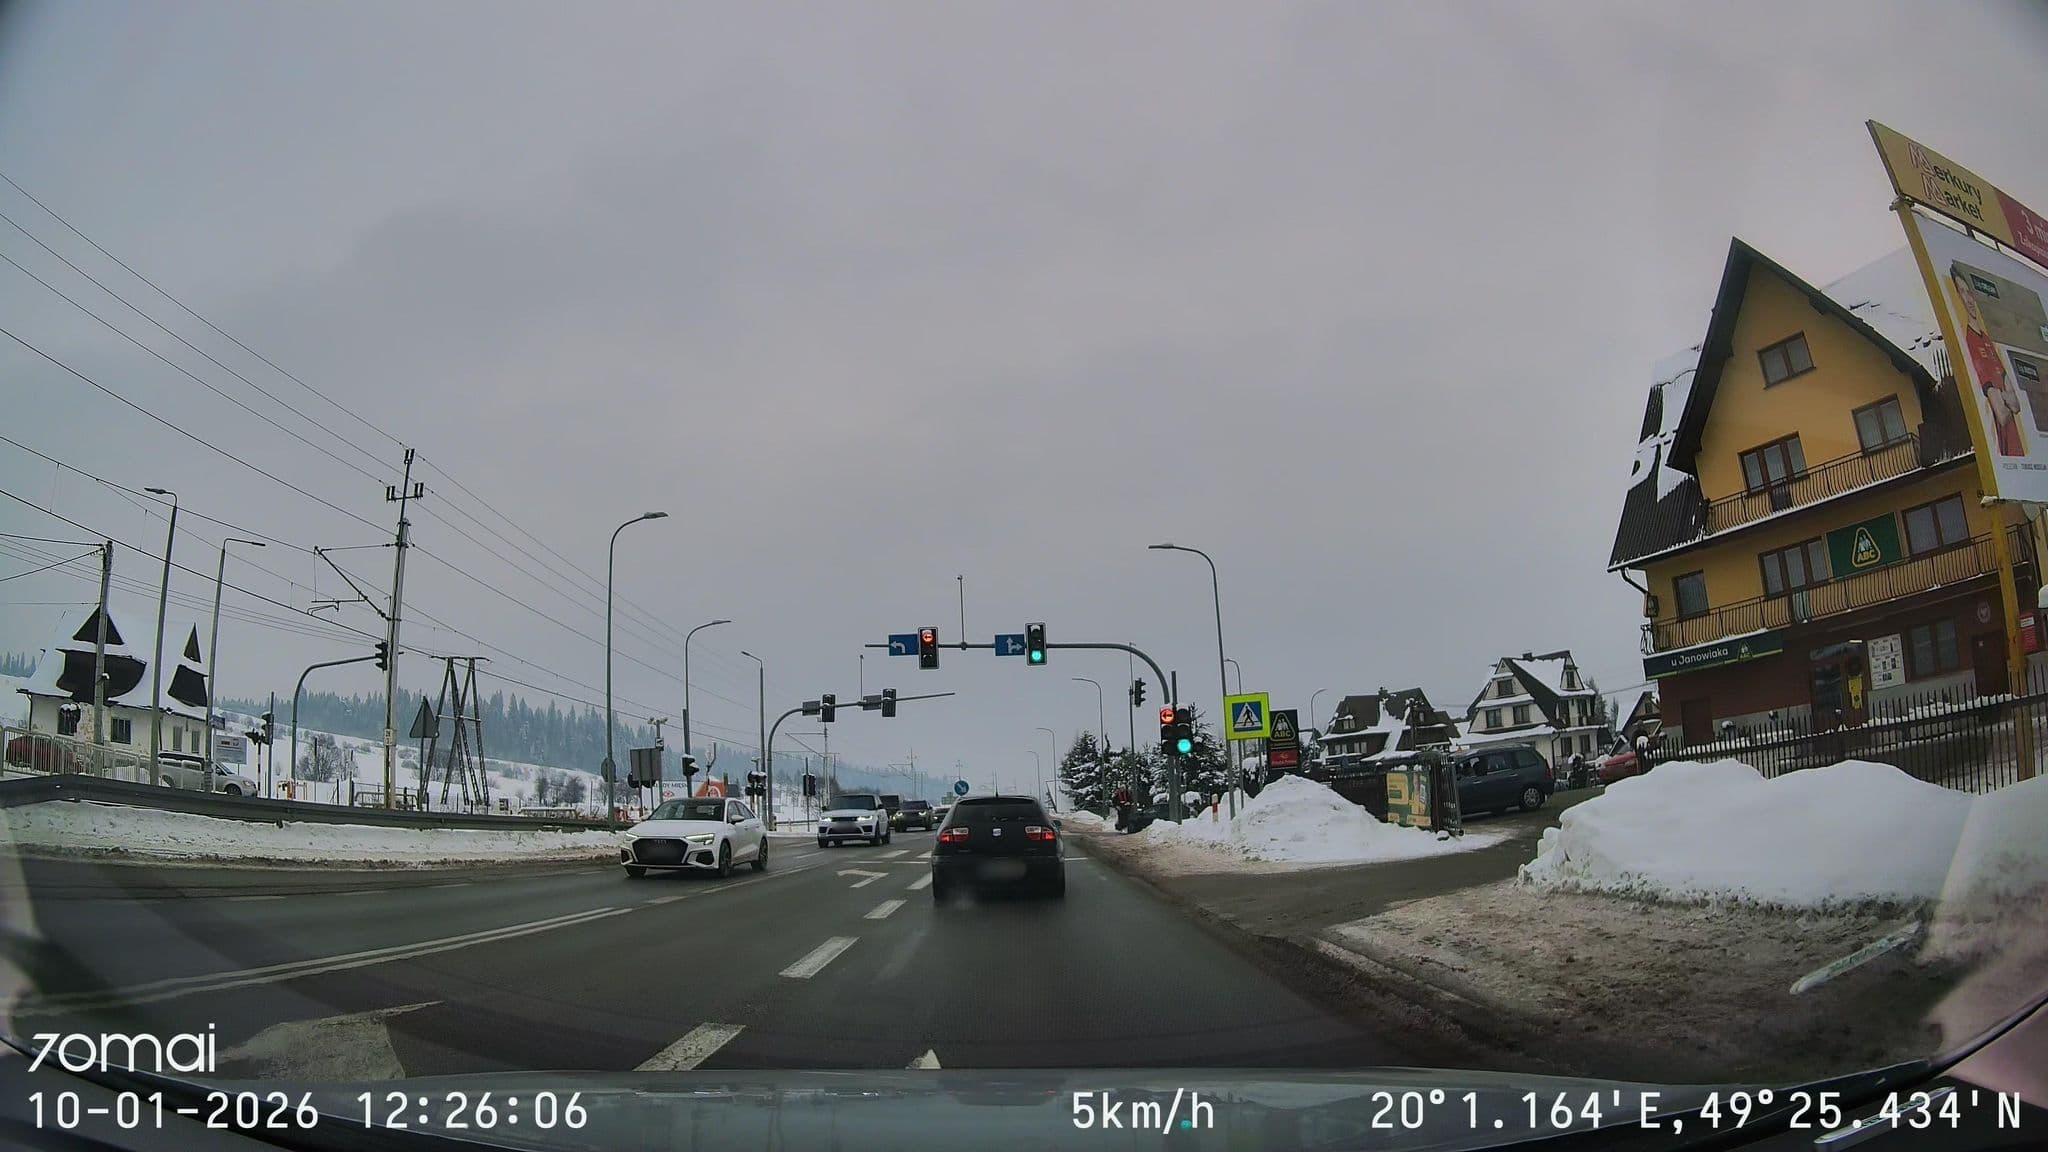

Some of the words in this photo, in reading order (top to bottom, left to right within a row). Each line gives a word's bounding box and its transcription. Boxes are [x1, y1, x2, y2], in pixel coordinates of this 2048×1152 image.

[1907, 142, 1983, 206] Merkury
[1921, 172, 1985, 222] Market
[1857, 549, 1877, 562] ABC
[1680, 647, 1729, 665] Janowiaka
[1274, 730, 1291, 738] ABC
